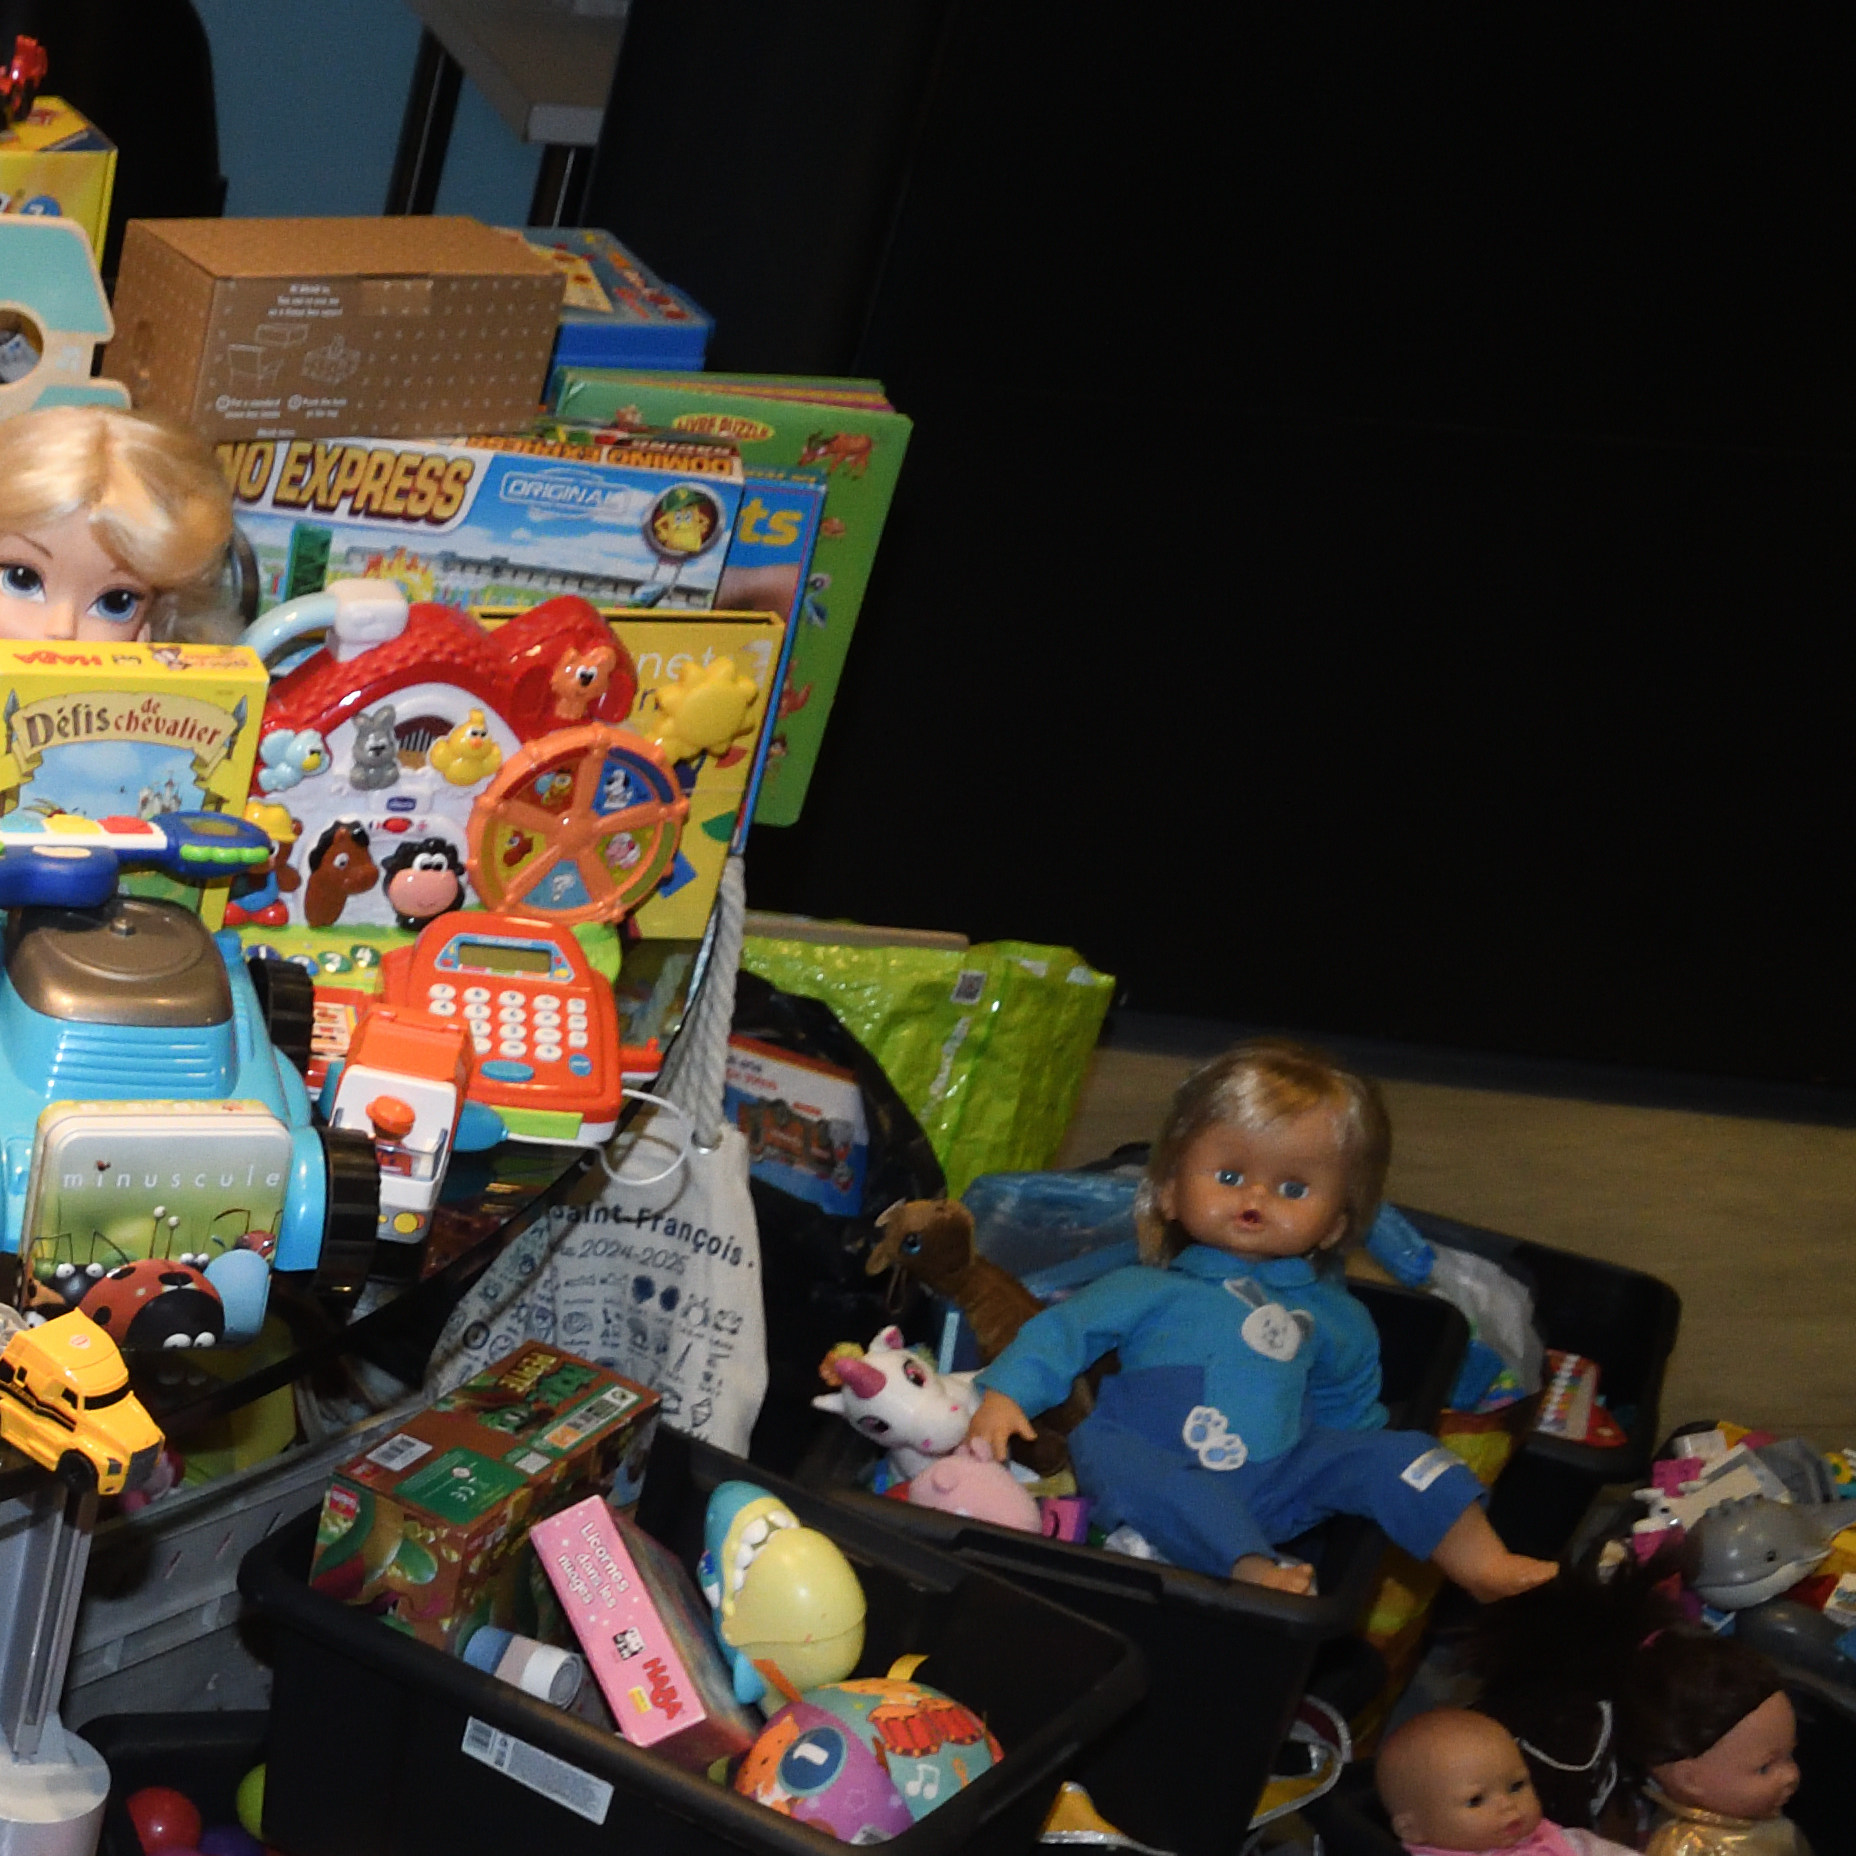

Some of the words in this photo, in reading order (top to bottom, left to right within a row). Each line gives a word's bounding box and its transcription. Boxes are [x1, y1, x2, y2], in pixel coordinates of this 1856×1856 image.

[288, 441, 476, 525] EXPRESS
[24, 702, 111, 748] Défis
[140, 697, 162, 715] de
[114, 712, 222, 748] chevalier
[61, 1165, 283, 1190] minuscule
[557, 1553, 593, 1606] nuages
[575, 1552, 604, 1589] dans
[580, 1522, 630, 1594] Licornes
[642, 1655, 686, 1721] HABA
